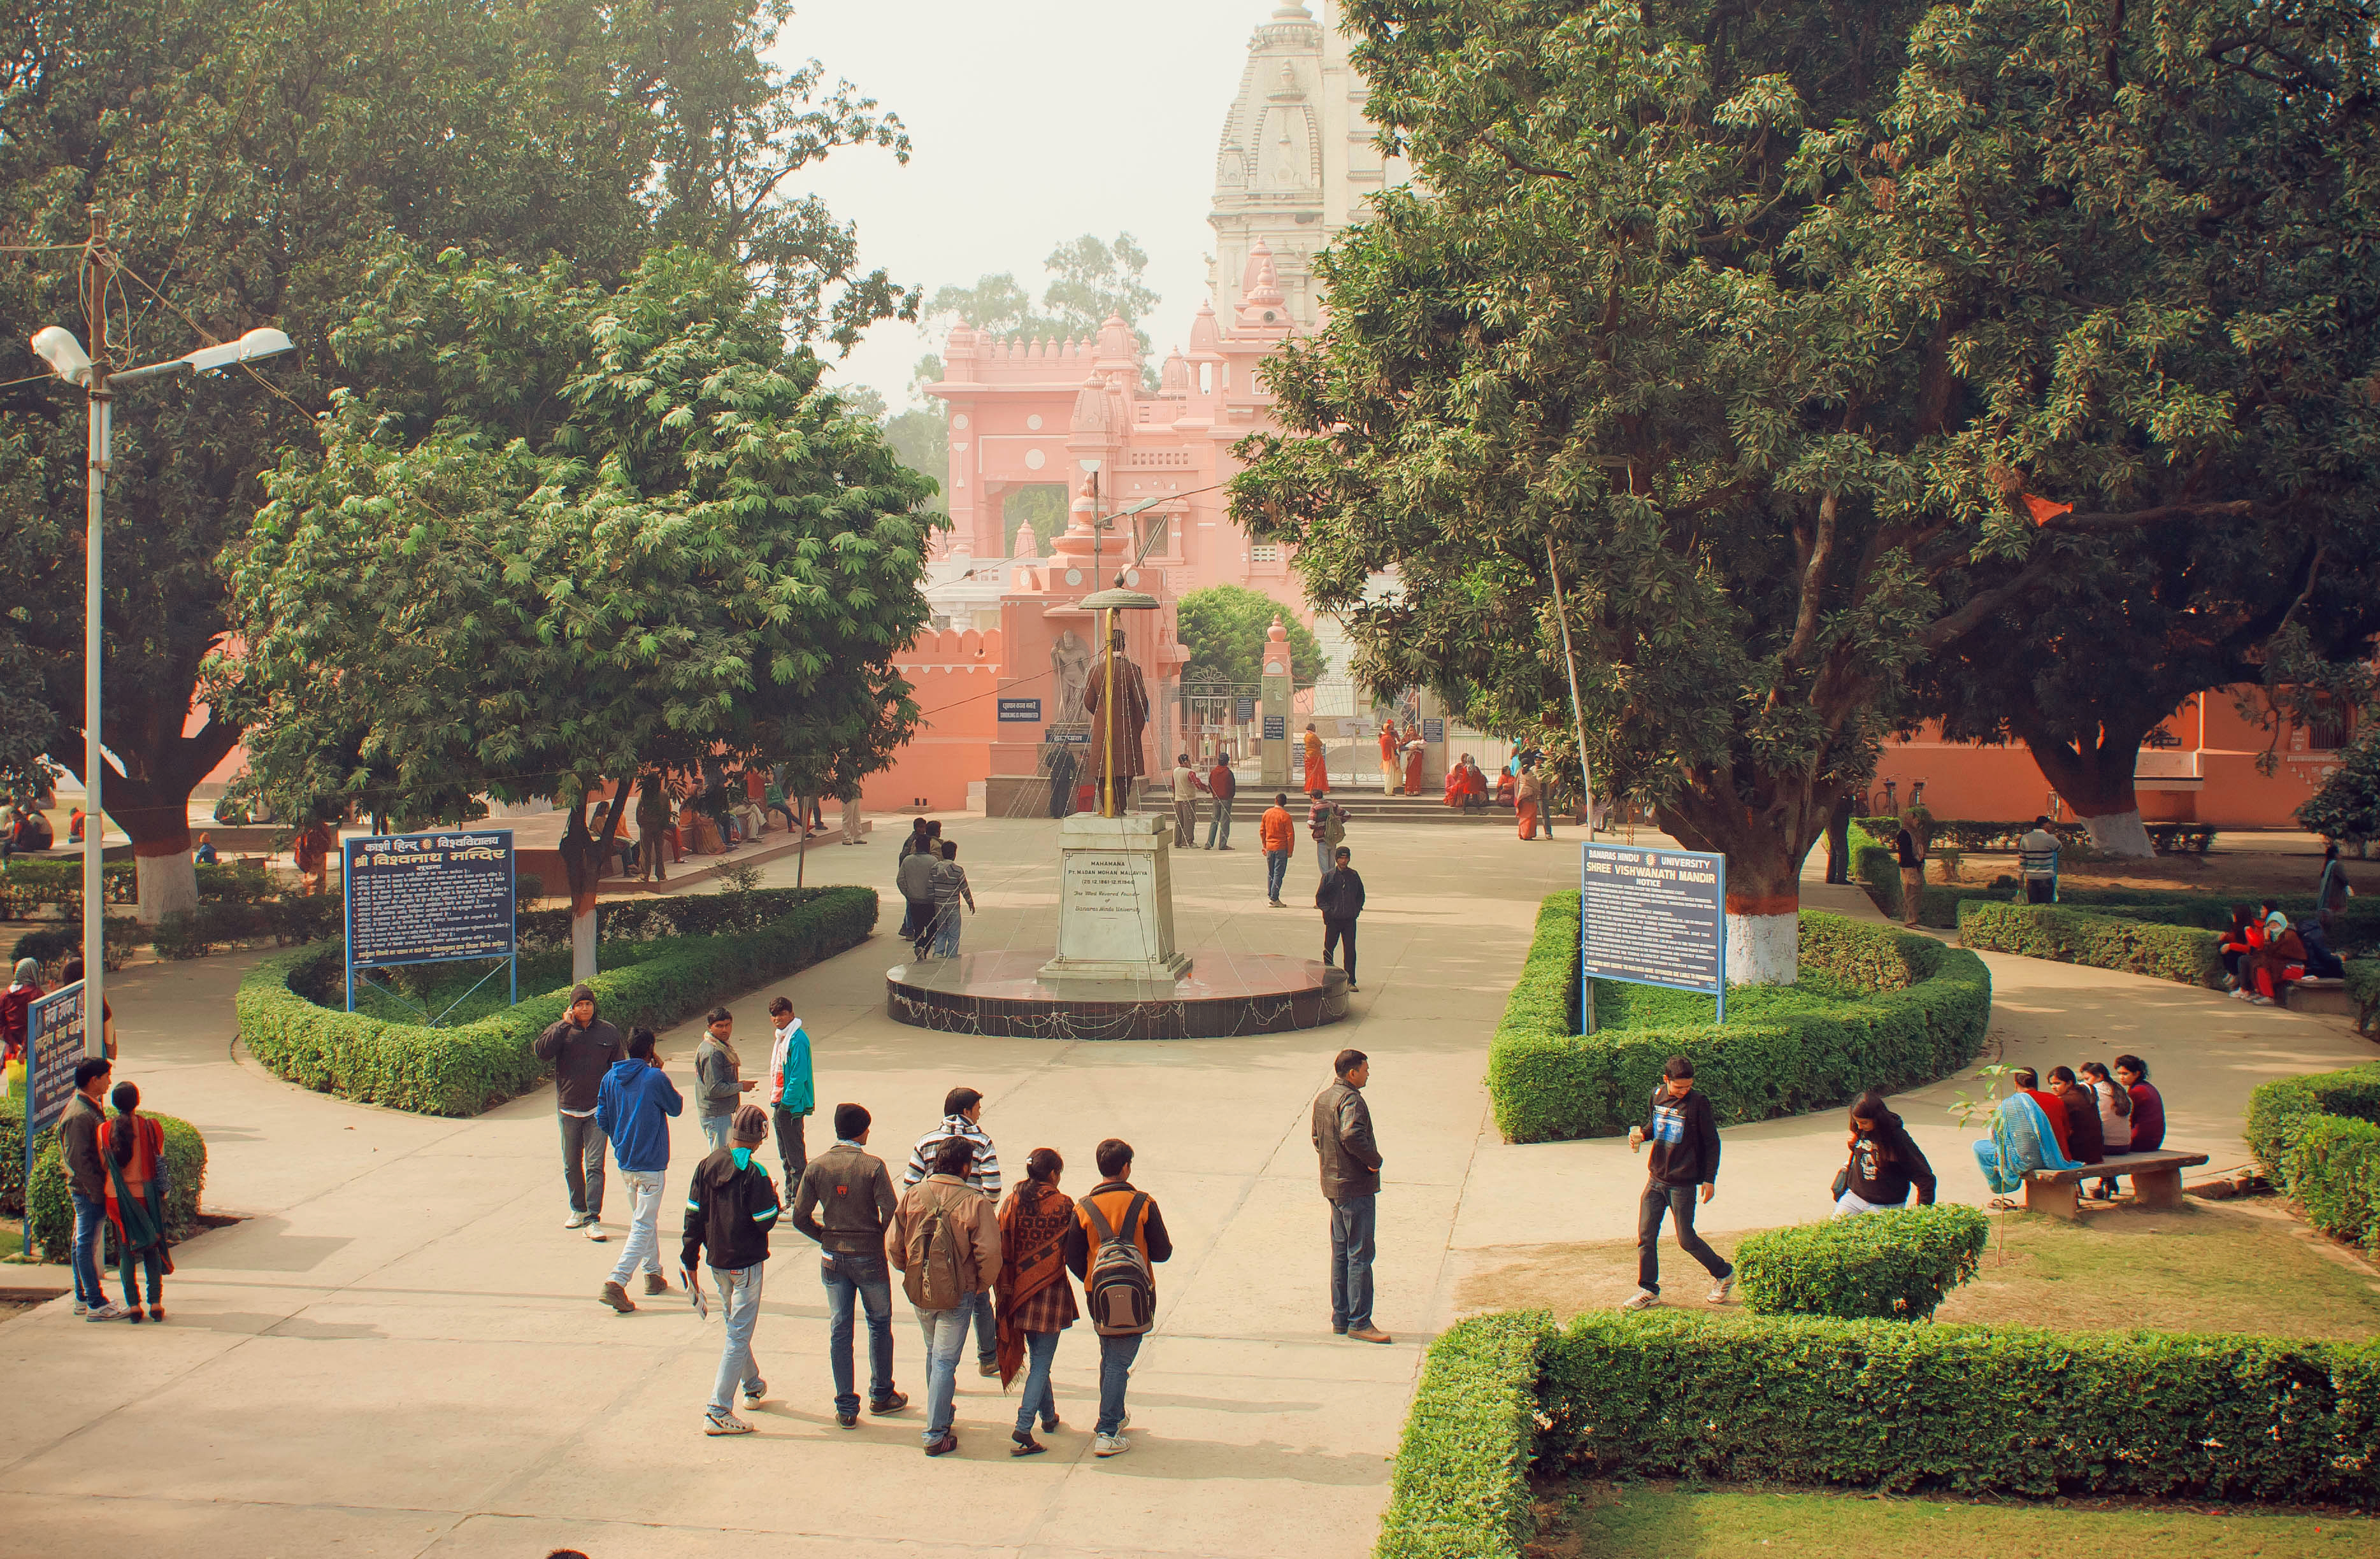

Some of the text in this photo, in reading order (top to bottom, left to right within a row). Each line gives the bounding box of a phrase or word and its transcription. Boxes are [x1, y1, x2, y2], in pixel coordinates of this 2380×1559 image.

[364, 836, 499, 852] काशी हिन्दू विश्वविद्यालय
[354, 847, 506, 868] श्री विश्वनाथ मन्दिर
[1588, 850, 1711, 869] BANARAS HINDU UNIVERSITY
[1586, 861, 1716, 885] SHREE VISHWANATH MANDIR
[1636, 878, 1661, 887] NOTICE
